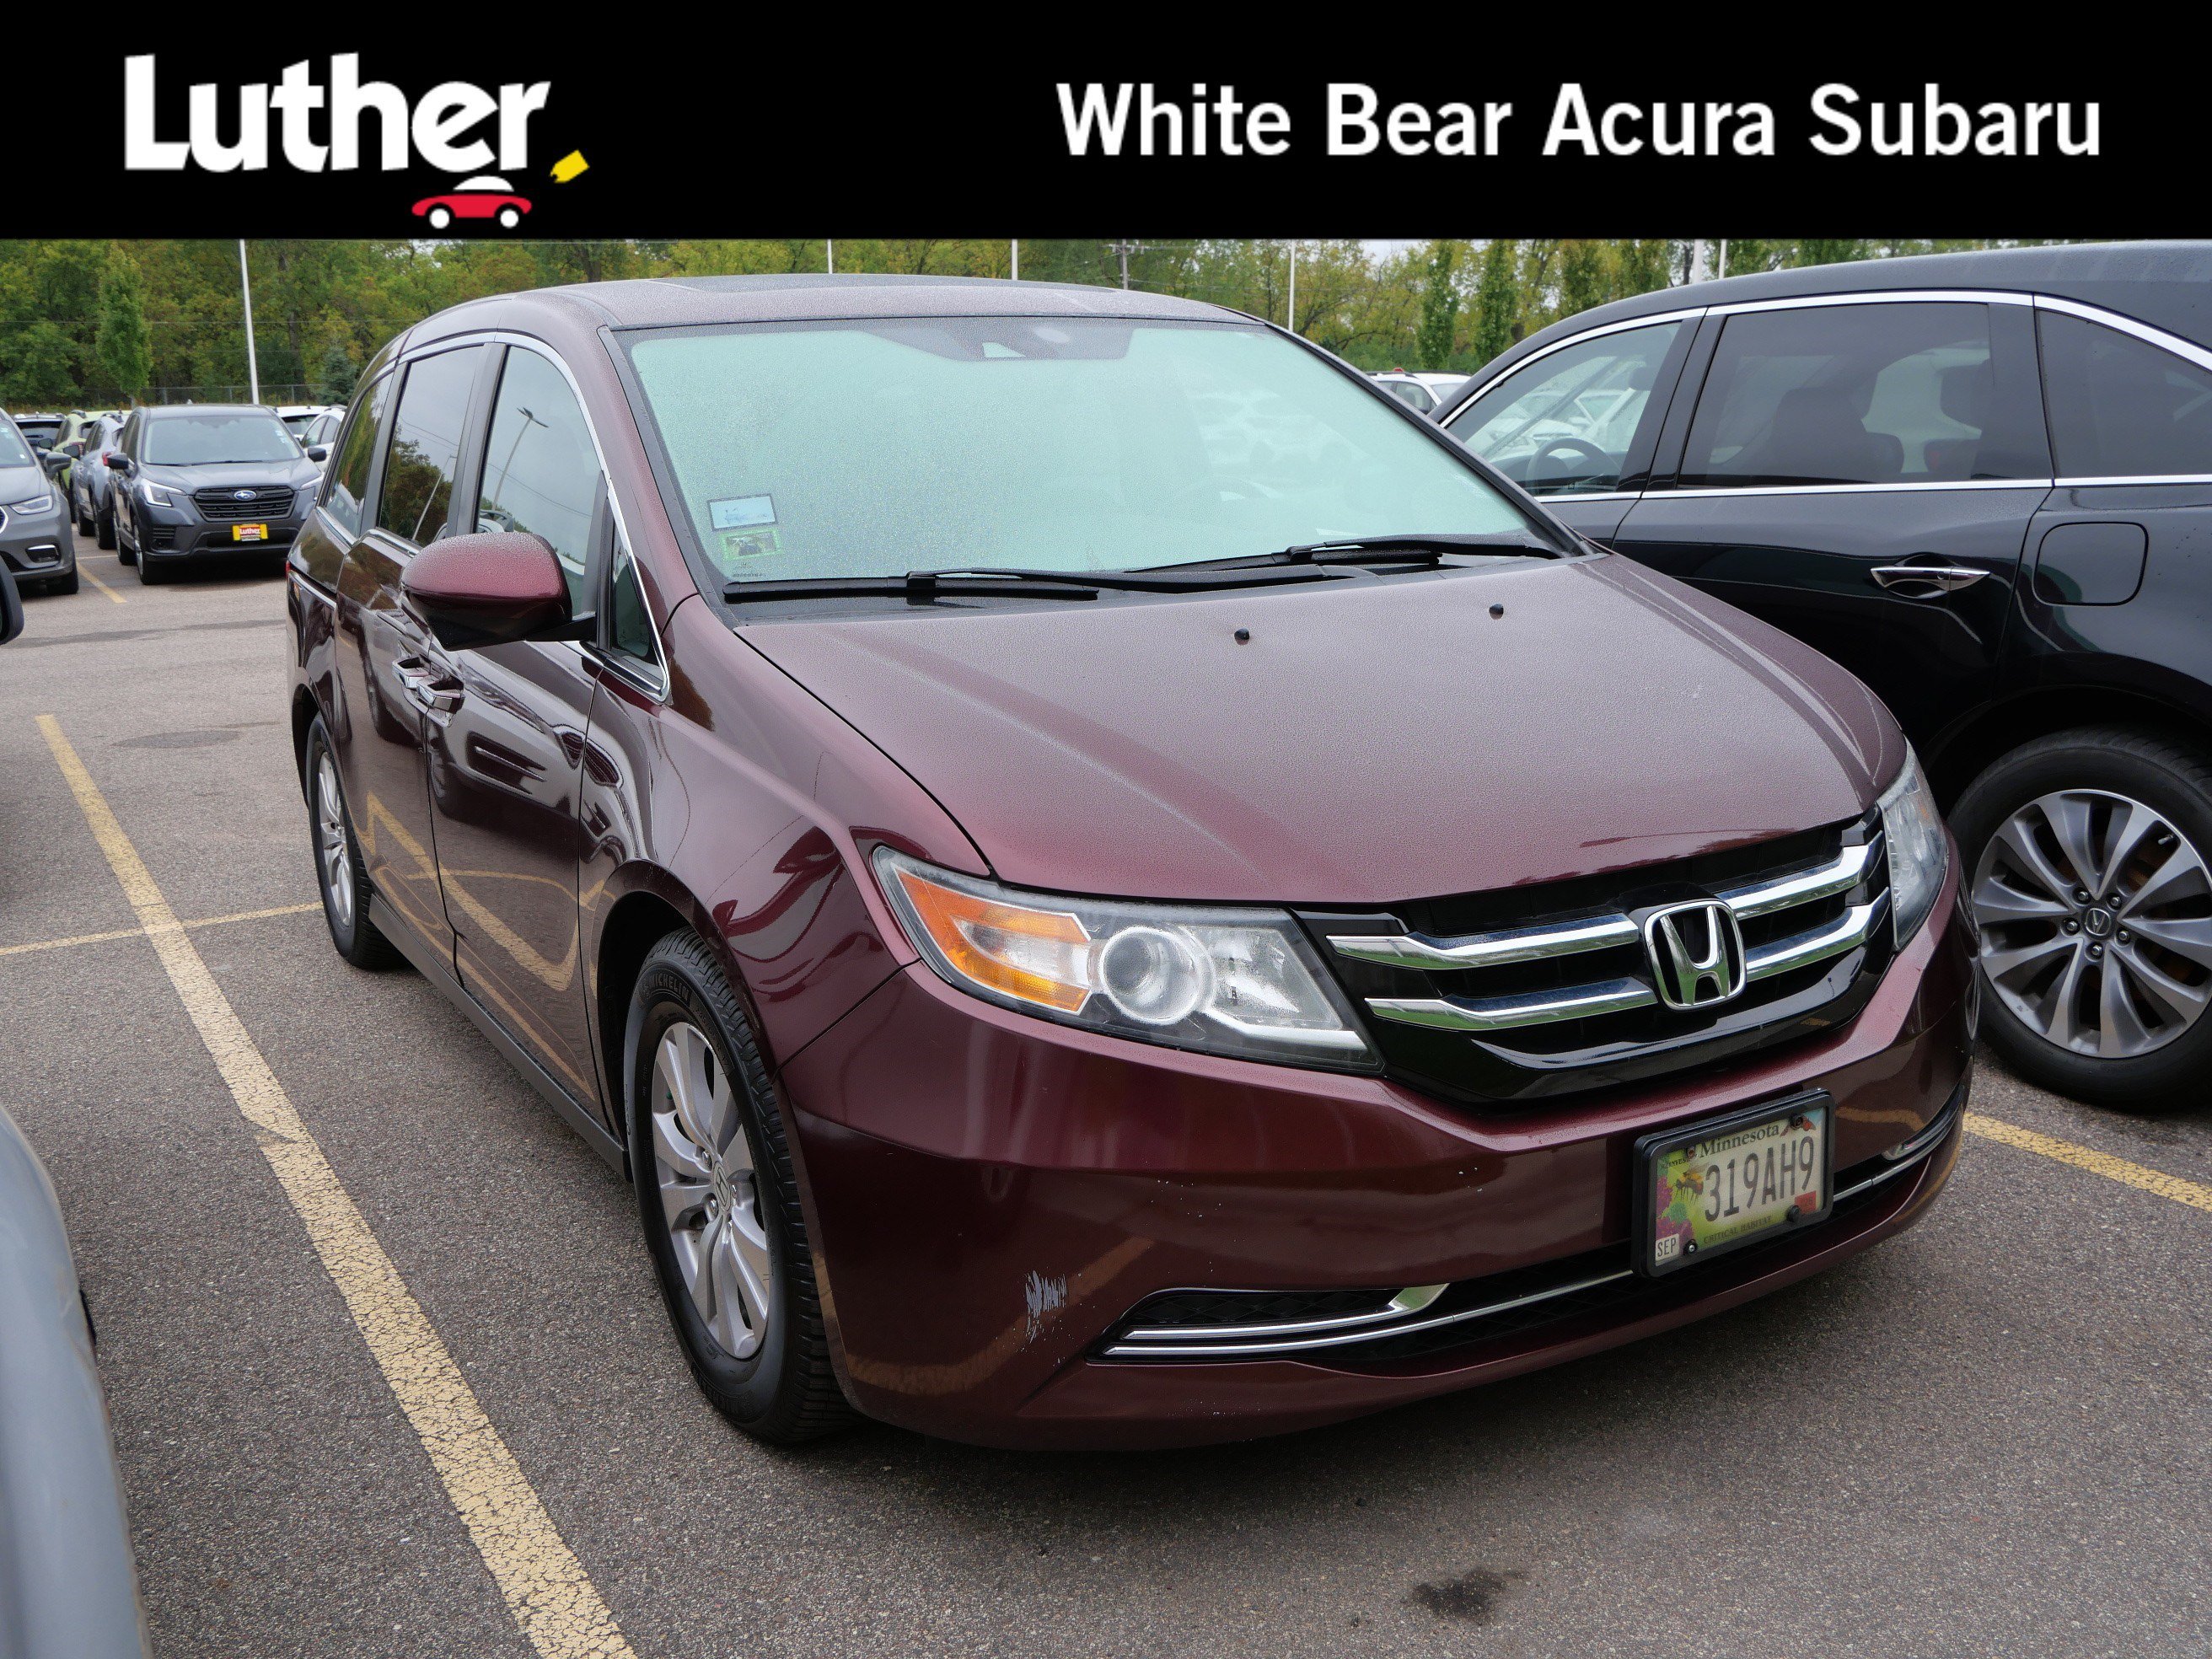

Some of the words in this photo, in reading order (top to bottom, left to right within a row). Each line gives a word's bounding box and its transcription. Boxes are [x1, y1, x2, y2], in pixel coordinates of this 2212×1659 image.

[649, 973, 691, 1001] MICHELIN
[1699, 1124, 1780, 1158] Minnesota
[1704, 1136, 1815, 1222] 319AH9
[1703, 1227, 1739, 1244] CRITICAL
[1741, 1215, 1772, 1234] HABITAT
[1656, 1238, 1678, 1258] SEP
